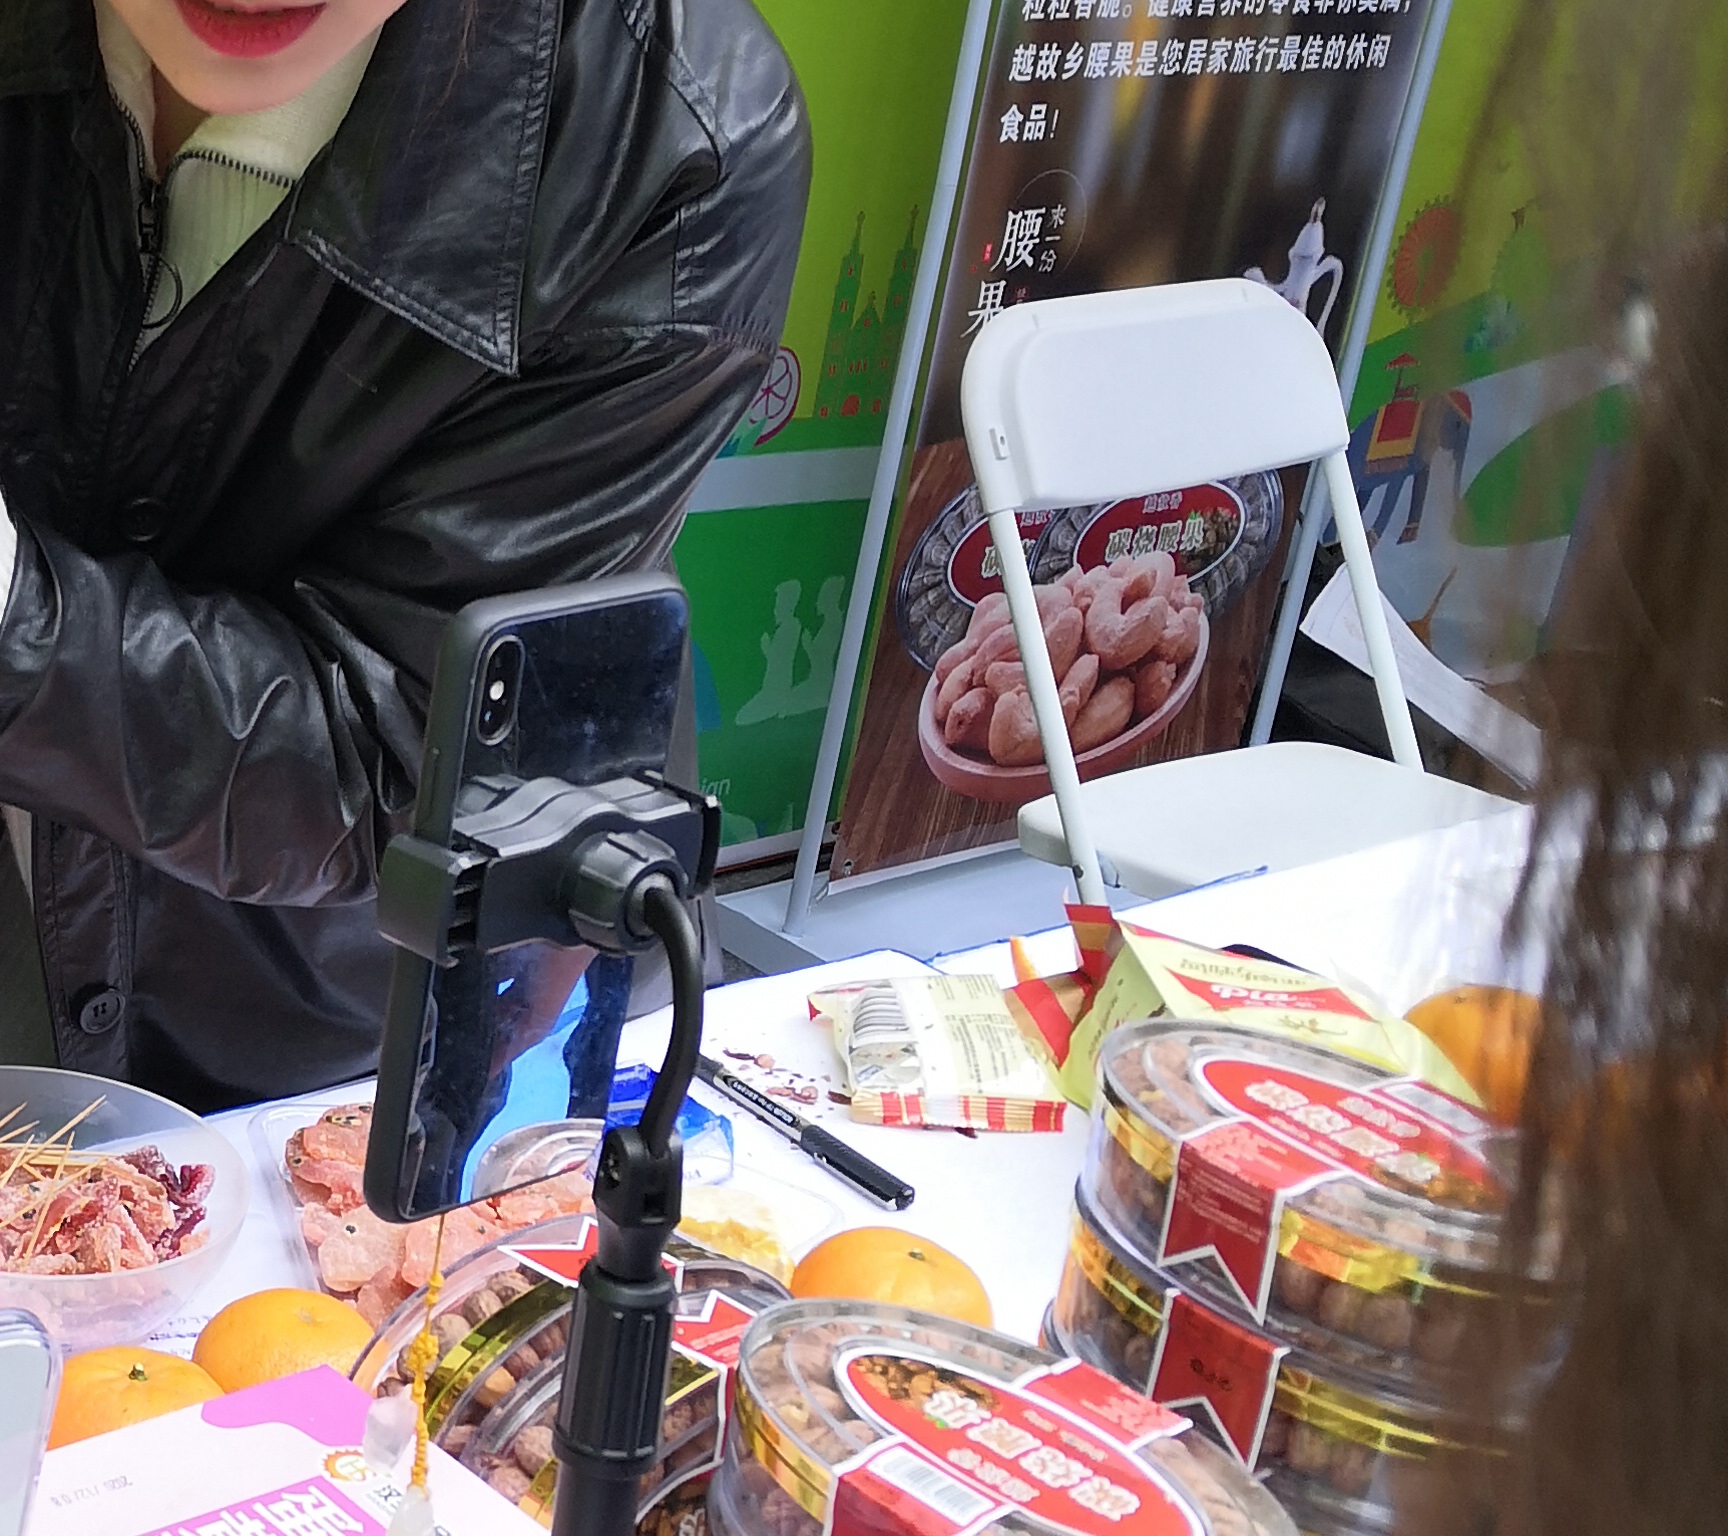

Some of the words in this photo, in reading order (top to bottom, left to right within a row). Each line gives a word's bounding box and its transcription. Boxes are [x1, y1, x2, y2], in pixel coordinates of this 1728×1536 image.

[1008, 31, 1390, 83] 越故乡腰果是您居家旅行最佳的休闲
[1104, 517, 1205, 562] 碳烧腰果
